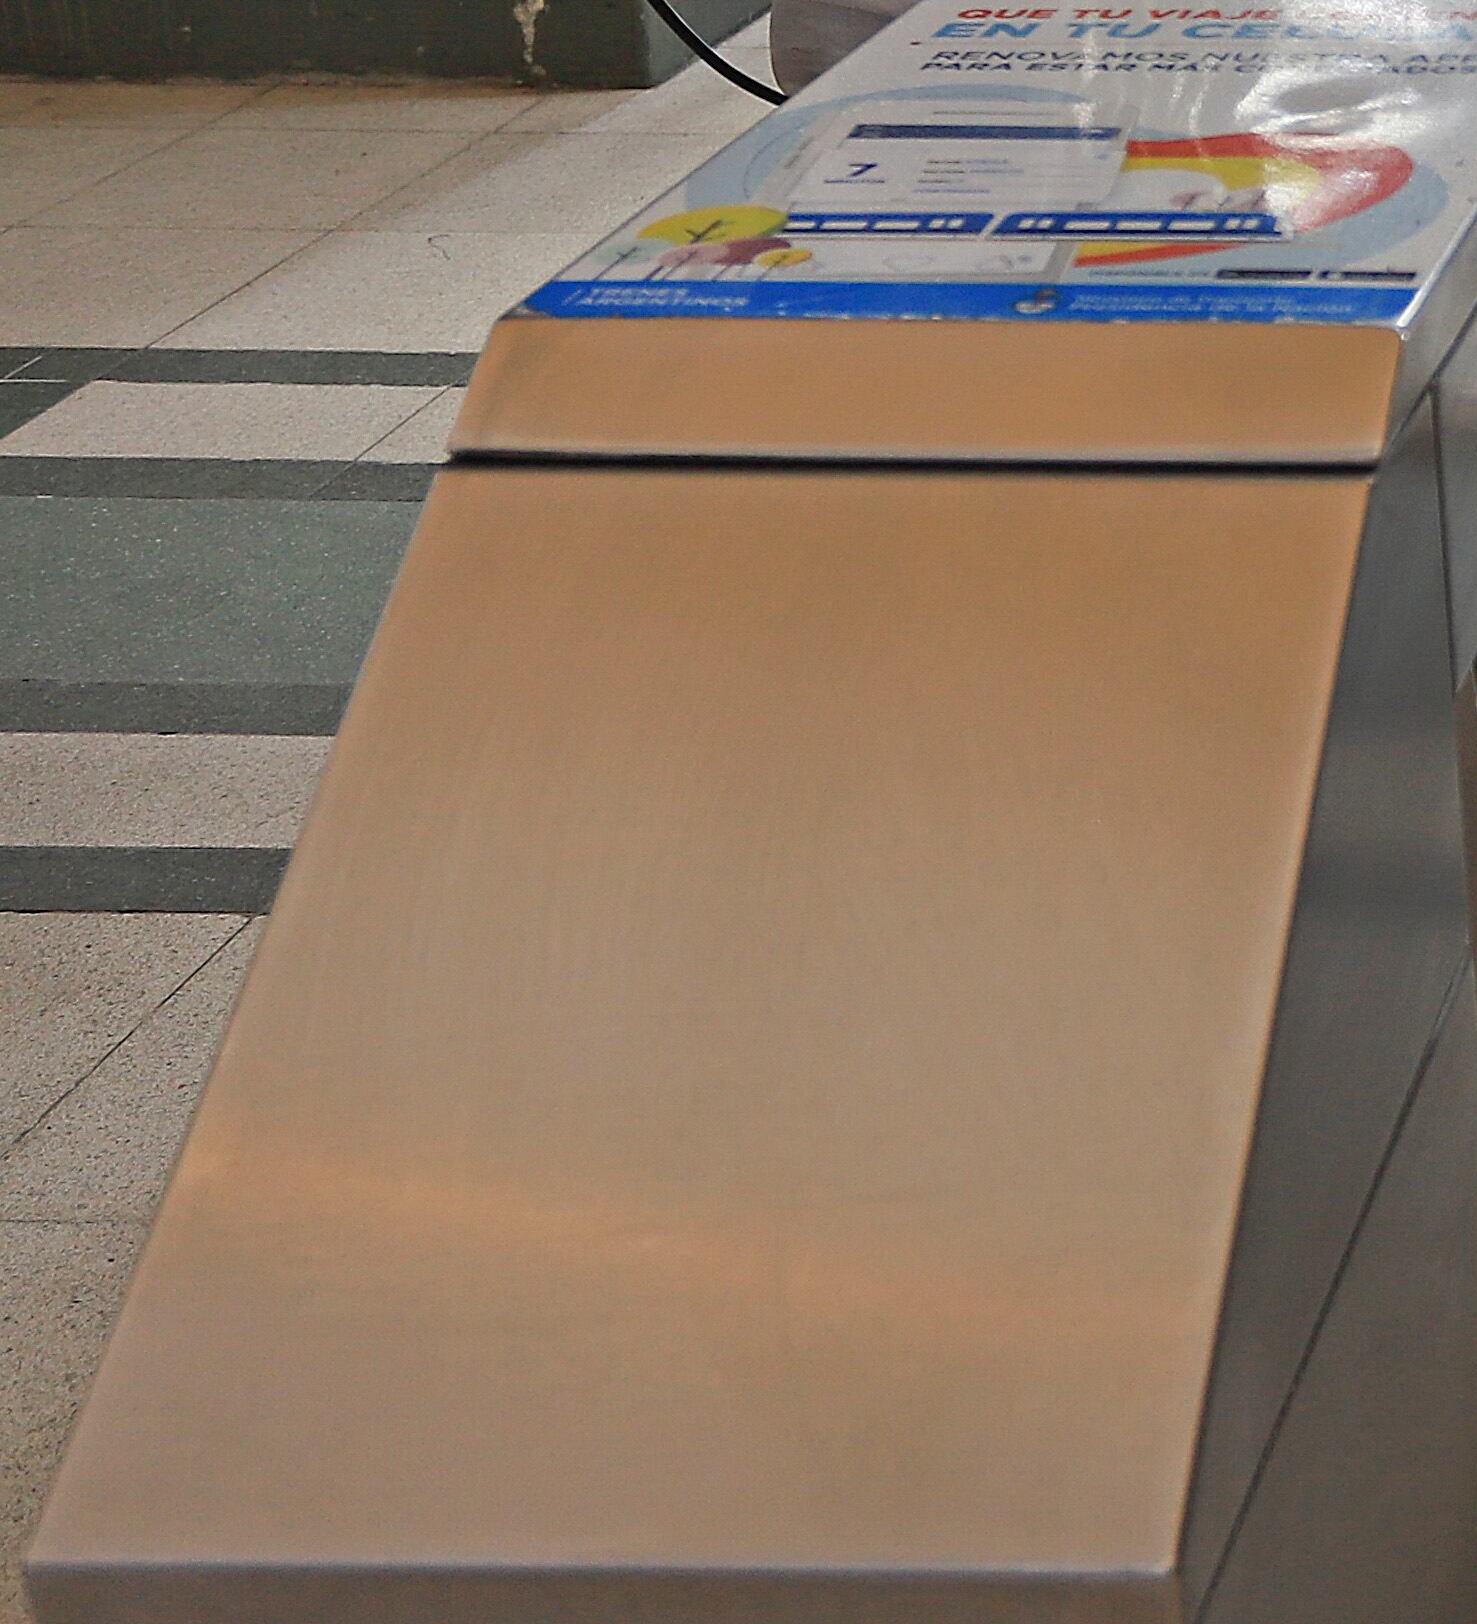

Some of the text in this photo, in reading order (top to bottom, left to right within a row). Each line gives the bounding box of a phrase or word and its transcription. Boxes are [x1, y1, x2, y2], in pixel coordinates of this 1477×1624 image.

[956, 9, 1056, 19] QUE
[1073, 9, 1134, 19] TU
[1149, 9, 1280, 20] VIAJE
[932, 23, 1038, 38] EN
[1068, 23, 1158, 38] TU
[931, 51, 1190, 61] RENOVAMOS
[920, 62, 1014, 71] PARA
[1024, 63, 1139, 71] ESTAR
